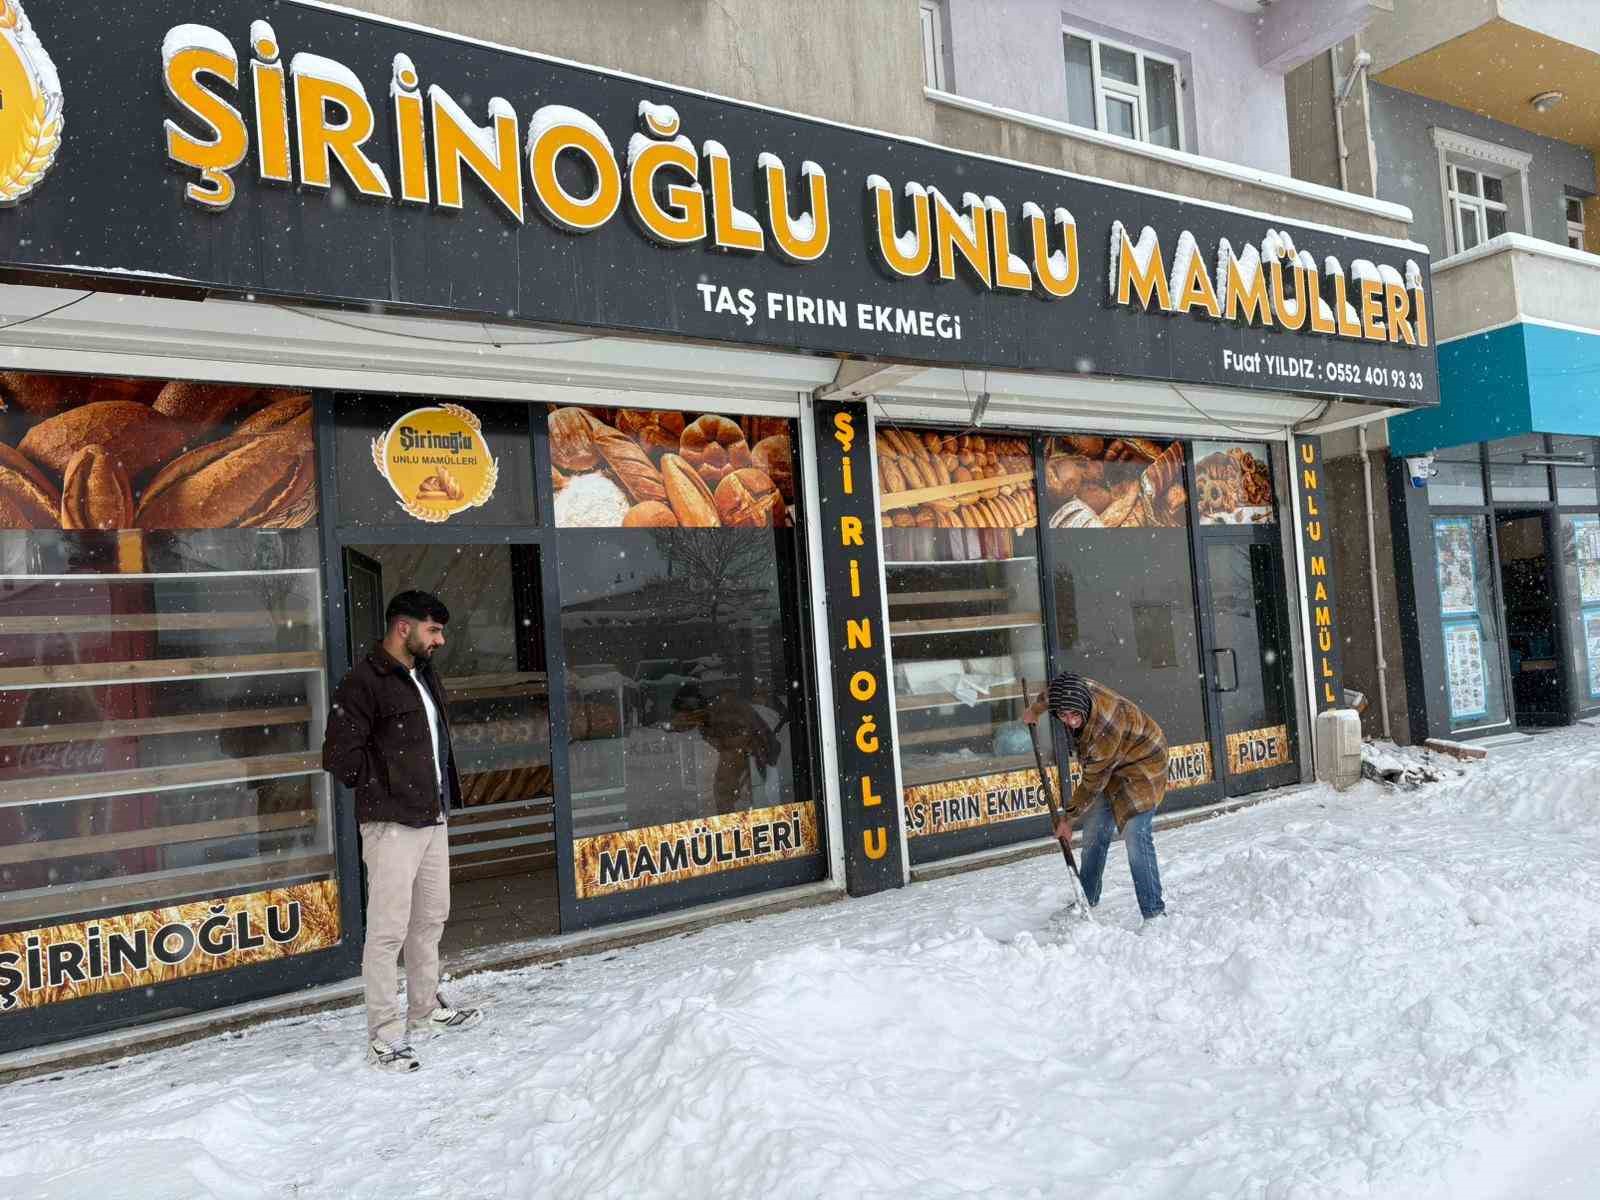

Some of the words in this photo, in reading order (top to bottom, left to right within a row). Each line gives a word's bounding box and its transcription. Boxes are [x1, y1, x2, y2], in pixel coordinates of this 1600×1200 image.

[164, 30, 831, 263] ŞİRİNOĞLU
[872, 180, 1081, 298] UNLU
[1112, 228, 1429, 348] MAMÜLLERİ
[697, 283, 757, 326] TAŞ
[767, 292, 847, 327] FIRIN
[1223, 349, 1260, 374] Fuat
[1265, 354, 1315, 379] YILDIZ
[1326, 362, 1361, 384] 0552
[1365, 366, 1388, 386] 401
[1392, 369, 1406, 390] 93
[1409, 372, 1424, 391] 33
[393, 455, 419, 465] UNLU
[422, 454, 477, 465] MAMÜLLERİ
[1302, 443, 1321, 541] UNLU
[833, 411, 888, 860] ŞİRİNOĞLU
[1311, 556, 1335, 703] MAMÜLL
[1239, 735, 1277, 765] PİDE
[599, 810, 801, 886] MAMÜLLERİ
[903, 802, 926, 834] AŞ
[931, 794, 981, 825] FIRIN
[0, 902, 301, 1010] ŞİRİNOĞLU
